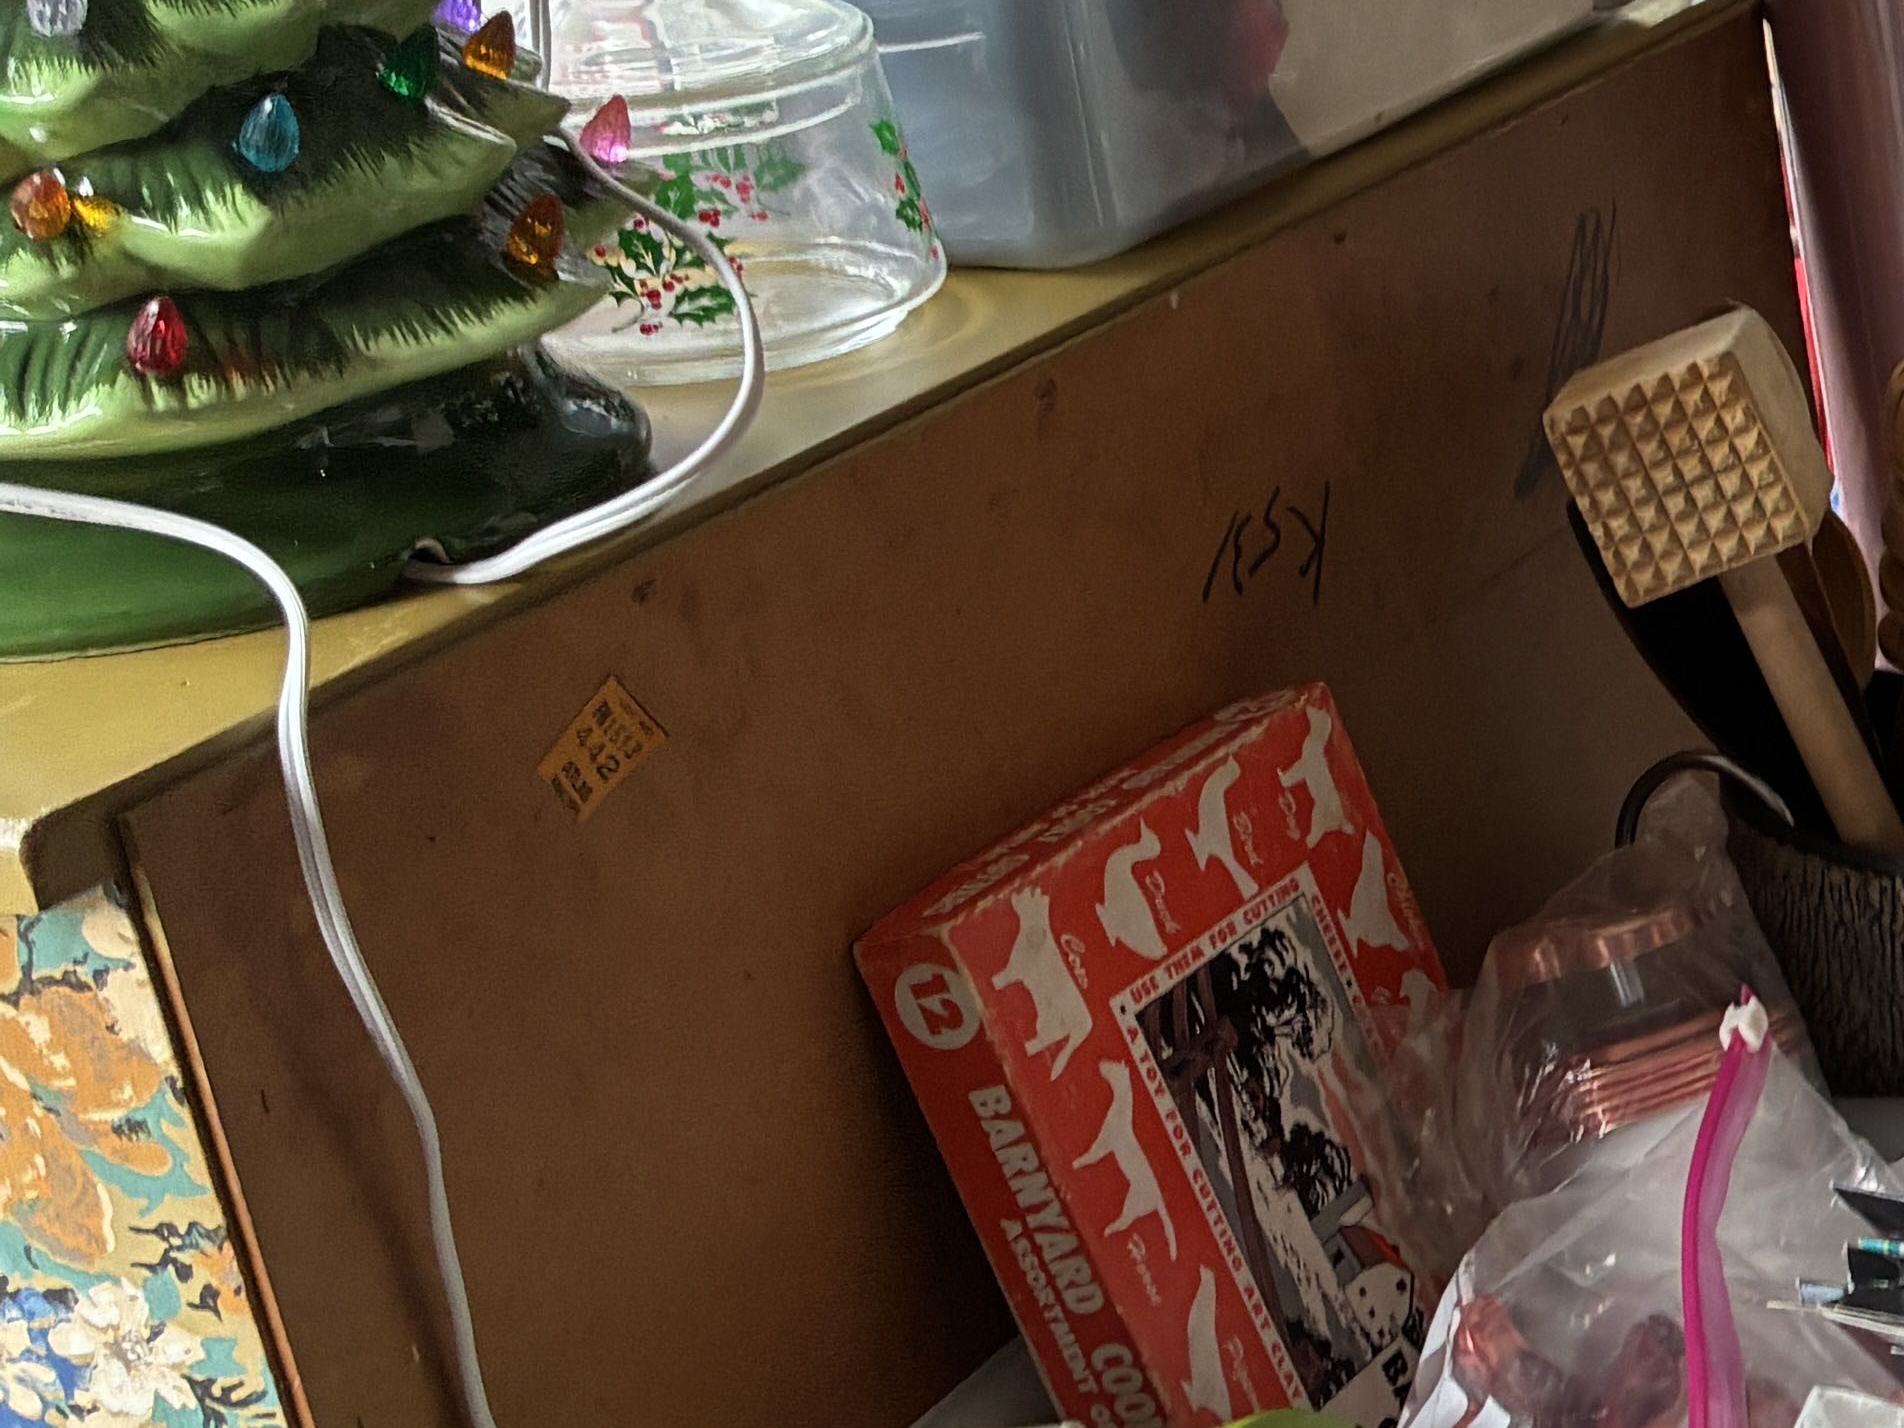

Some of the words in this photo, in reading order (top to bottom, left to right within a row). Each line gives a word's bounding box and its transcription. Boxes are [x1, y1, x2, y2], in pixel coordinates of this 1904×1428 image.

[1242, 877, 1300, 927] CUTTING
[907, 972, 965, 1036] 12
[968, 1083, 1104, 1315] BARNYARD
[1192, 1169, 1243, 1273] CUTTING
